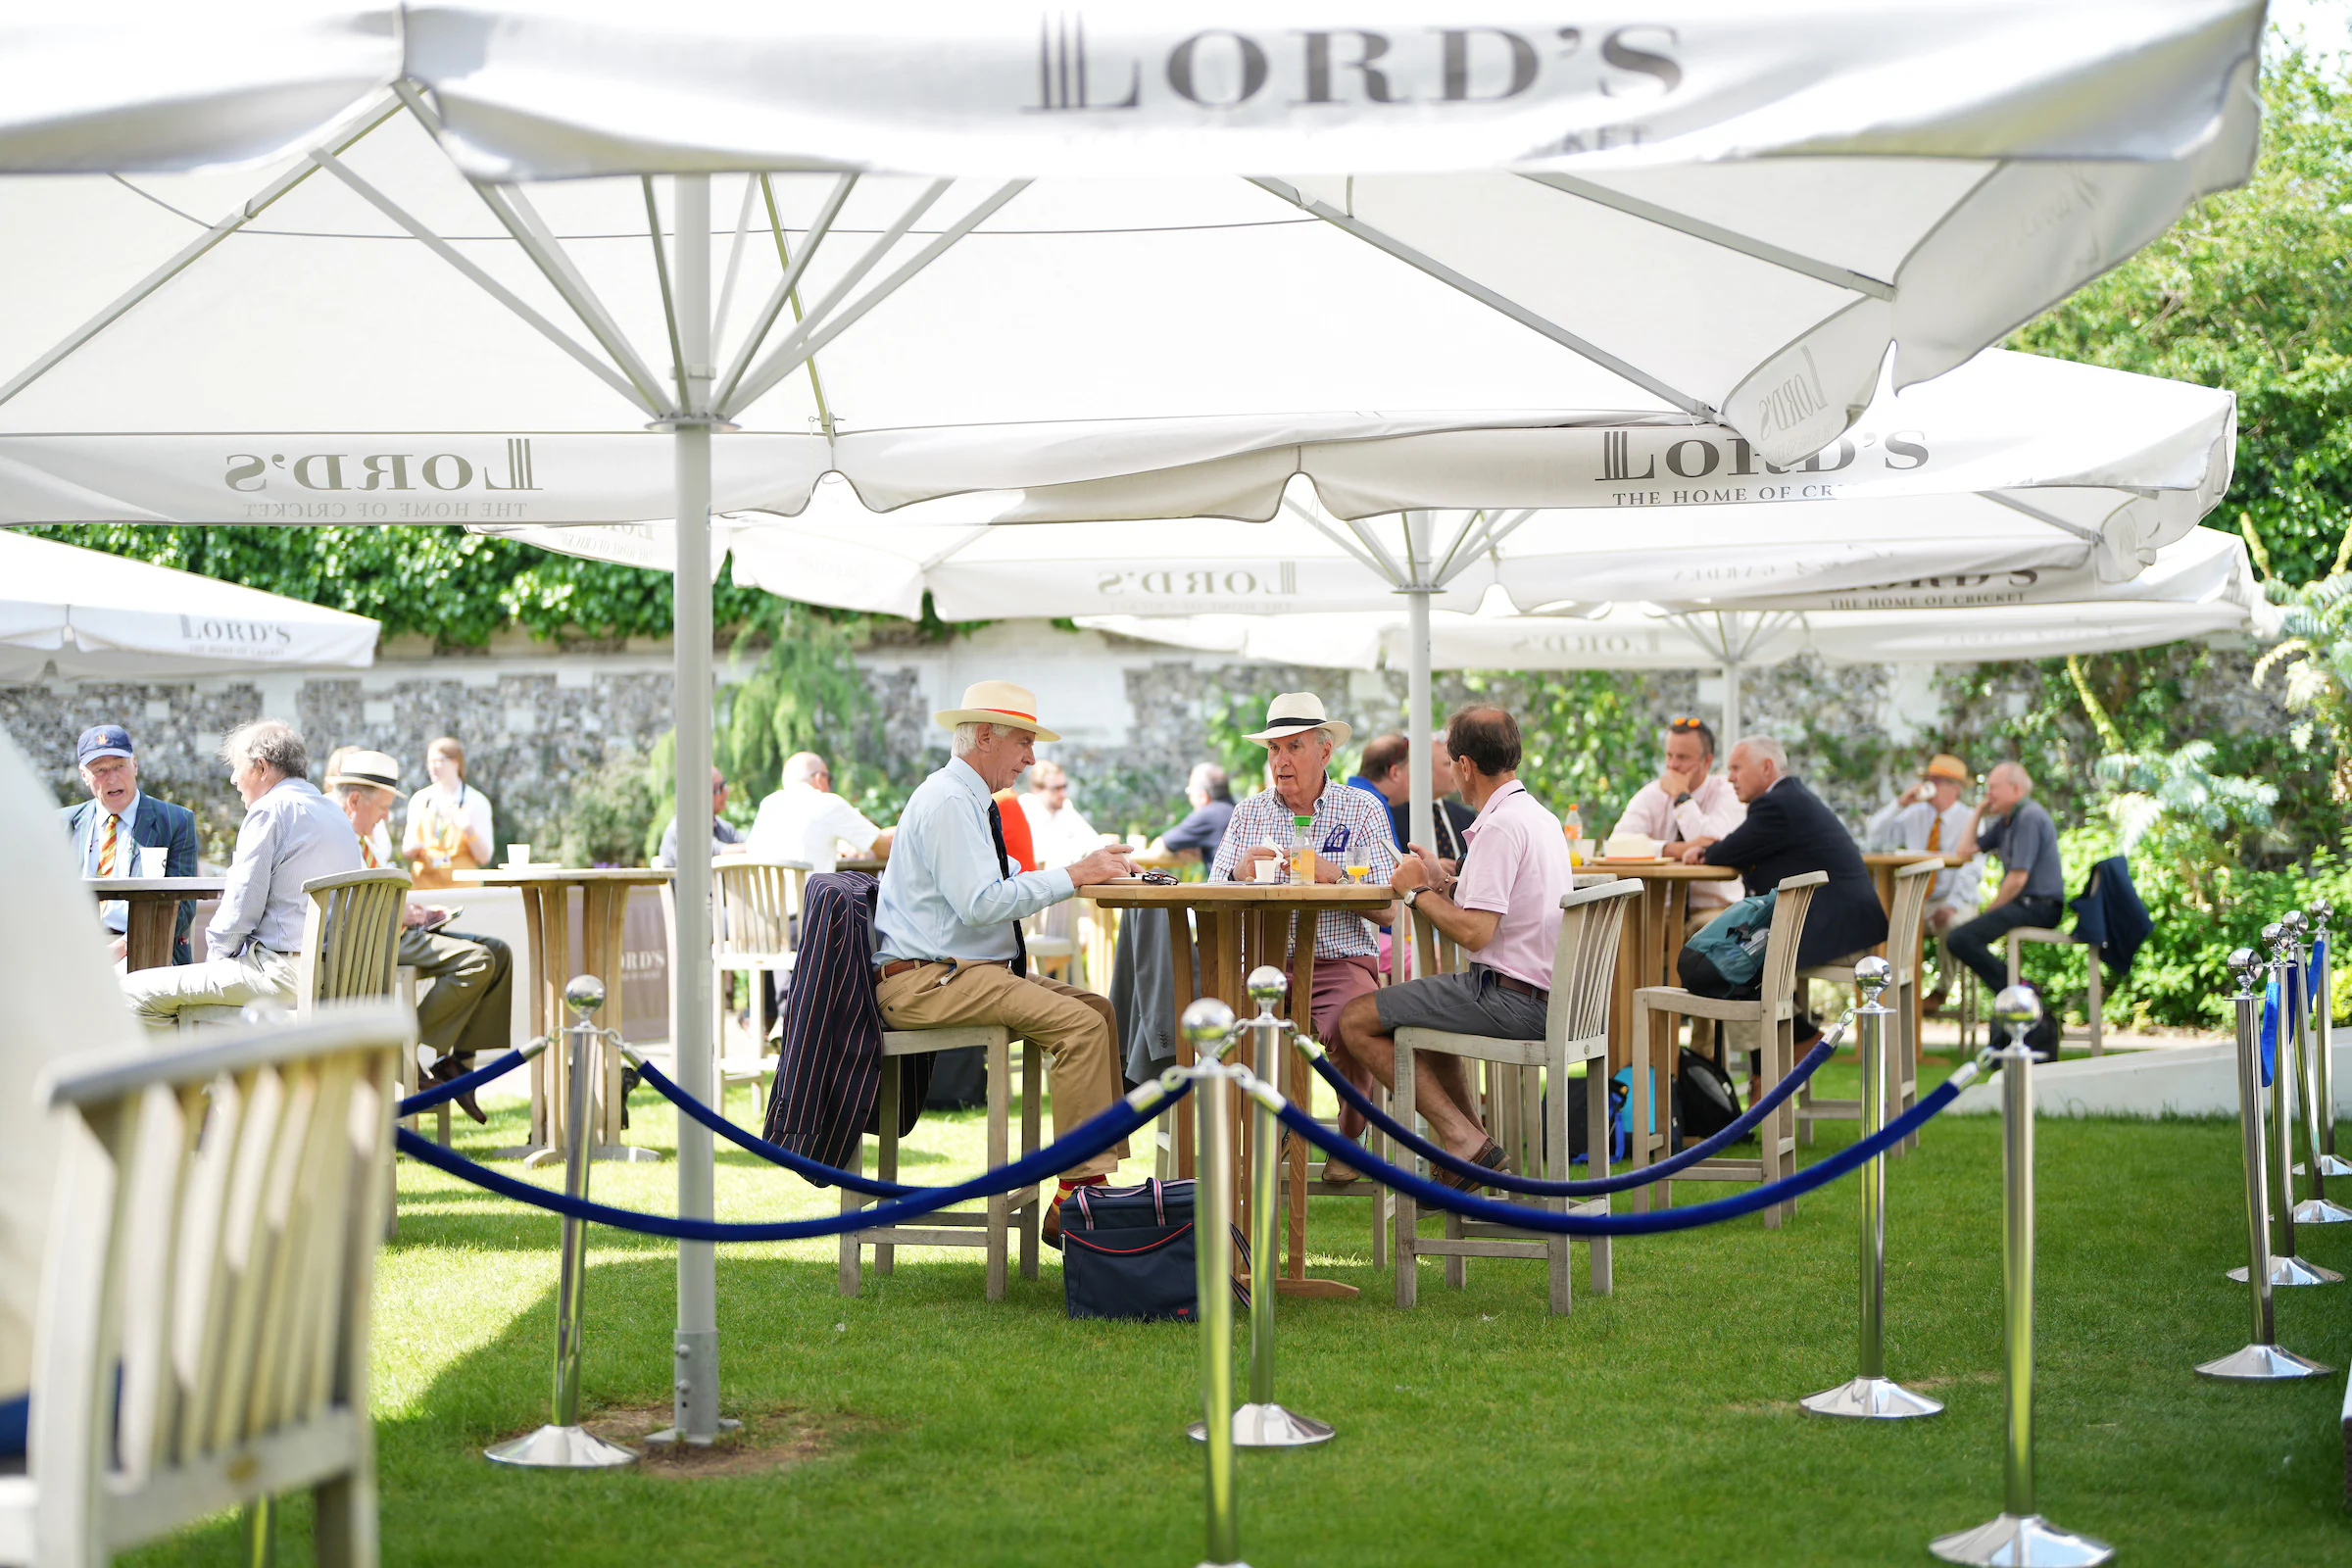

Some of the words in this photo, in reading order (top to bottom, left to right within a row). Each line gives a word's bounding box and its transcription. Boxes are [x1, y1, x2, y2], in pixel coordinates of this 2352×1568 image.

[1019, 10, 1684, 112] LORD'S
[1612, 491, 1661, 506] THE
[1672, 488, 1747, 504] HOME
[1759, 486, 1791, 500] OF
[1830, 597, 1861, 611] THE
[1868, 596, 1917, 609] HOME
[1925, 594, 1946, 607] OF
[1953, 591, 2027, 605] CRICKET
[180, 613, 292, 647] LORD'S
[620, 950, 665, 969] RD'S
